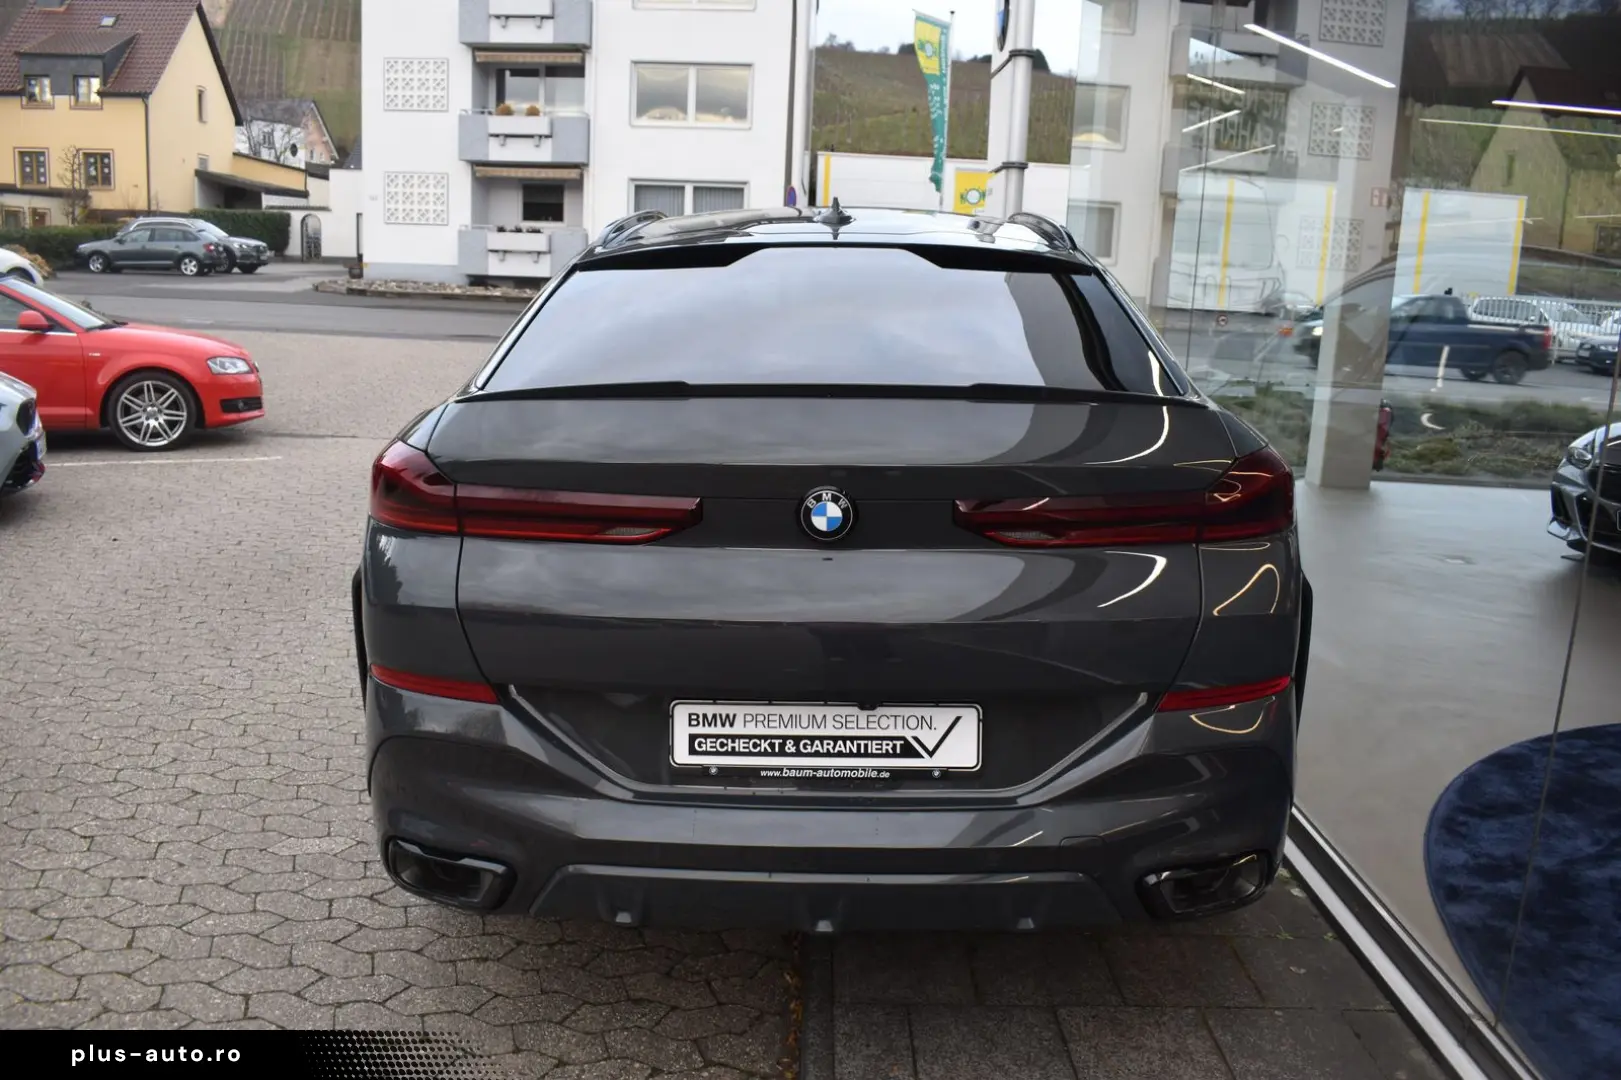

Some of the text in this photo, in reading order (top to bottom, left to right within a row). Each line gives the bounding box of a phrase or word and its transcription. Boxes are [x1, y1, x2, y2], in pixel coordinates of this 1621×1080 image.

[807, 492, 848, 509] BMW
[687, 712, 937, 731] BMW PREMIUM SELECTION.
[694, 738, 904, 754] GECHECKT & GARANTIERT
[760, 768, 890, 778] www.baum-automobile.de
